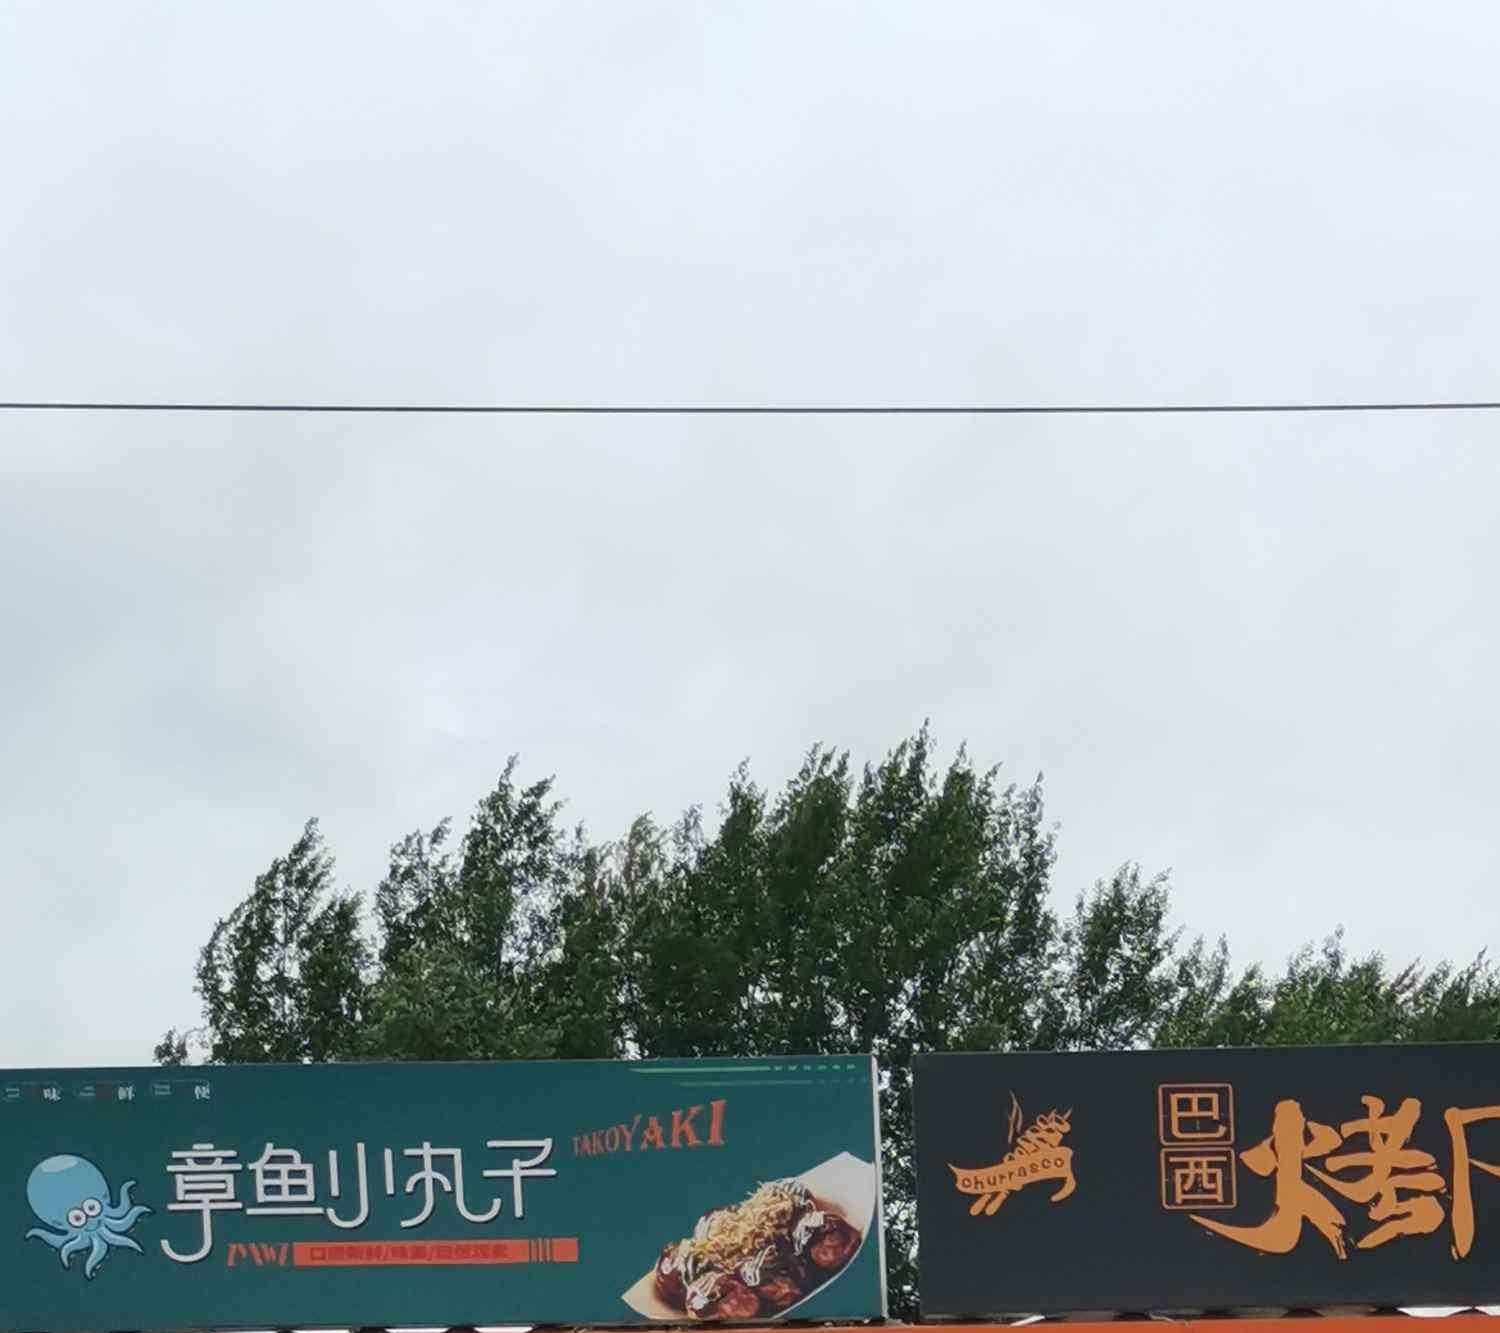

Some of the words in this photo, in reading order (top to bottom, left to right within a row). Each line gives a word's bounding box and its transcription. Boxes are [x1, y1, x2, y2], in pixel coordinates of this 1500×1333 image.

[571, 1098, 727, 1158] TAKOYAKI
[1169, 1092, 1228, 1205] 巴西
[160, 1137, 557, 1263] 章鱼小丸子
